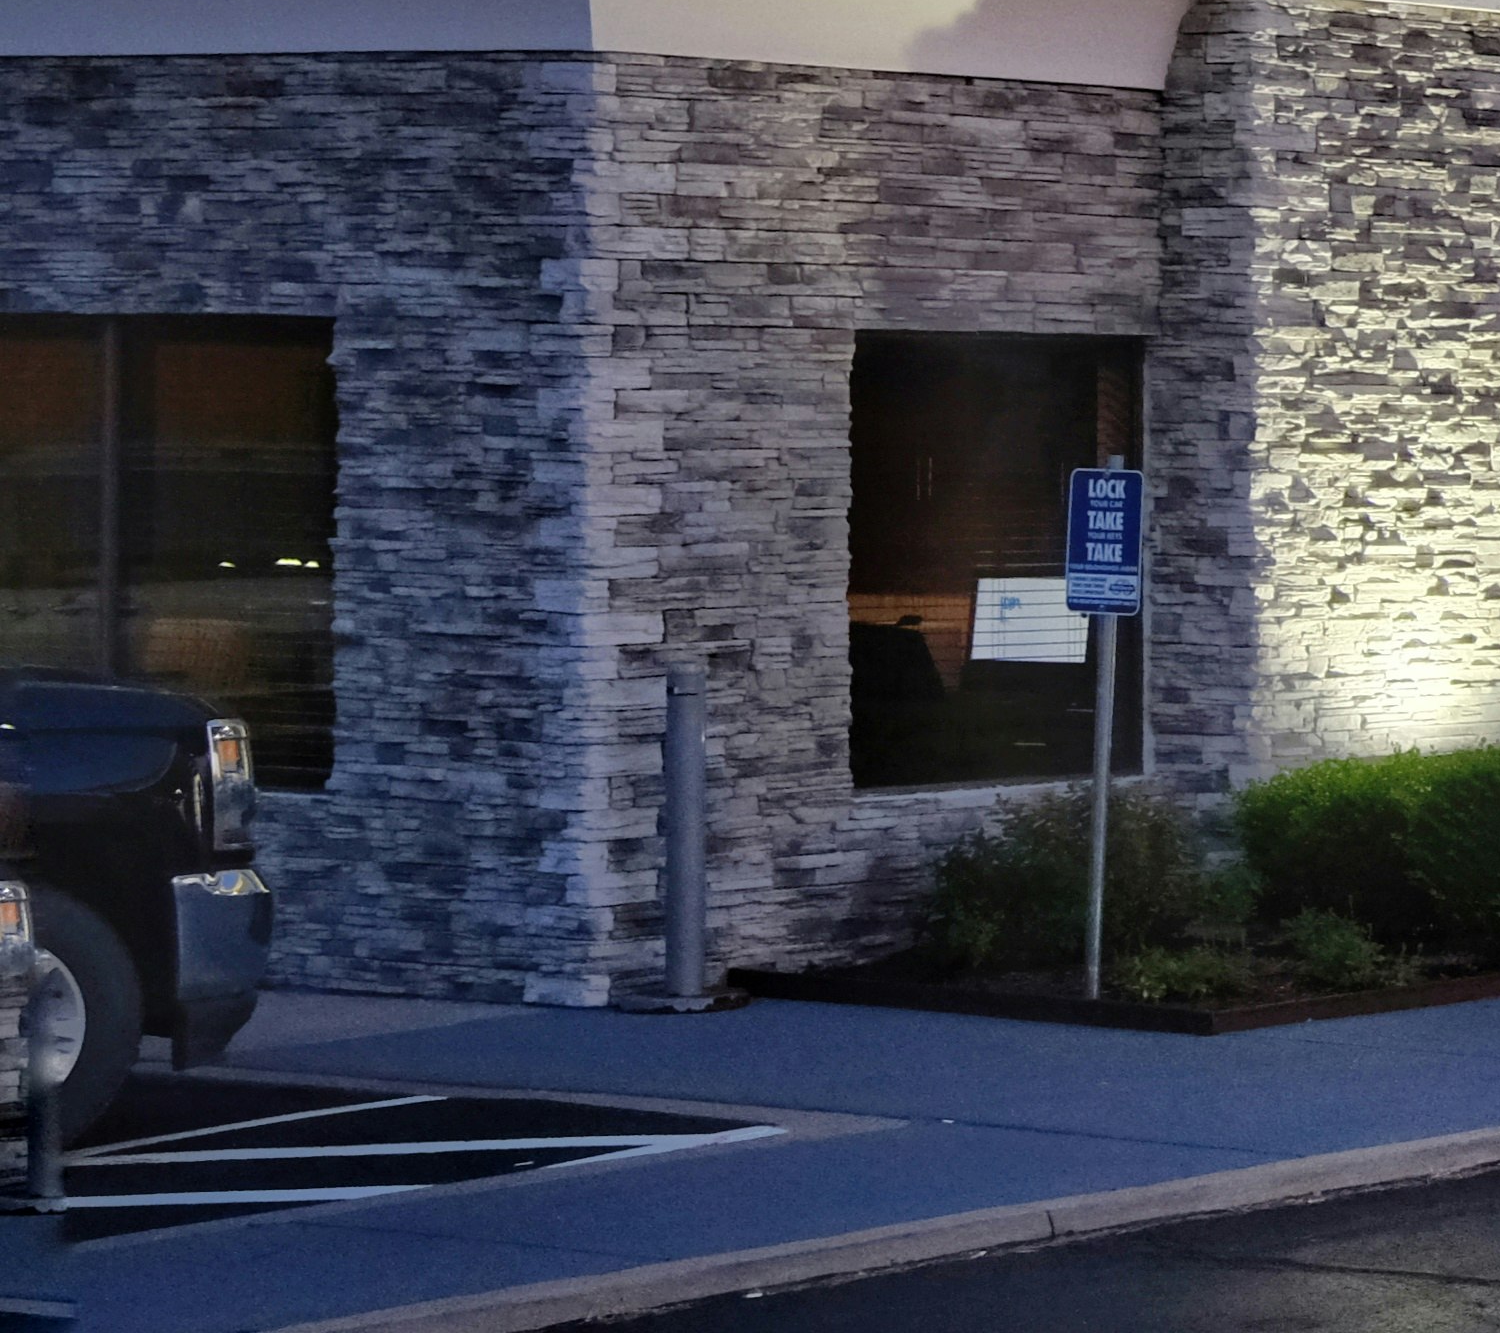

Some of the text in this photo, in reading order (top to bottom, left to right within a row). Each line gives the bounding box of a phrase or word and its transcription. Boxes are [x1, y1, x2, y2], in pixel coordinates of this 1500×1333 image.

[1088, 478, 1126, 499] LOCK
[1087, 510, 1124, 531] TAKE
[1085, 542, 1123, 563] TAKE
